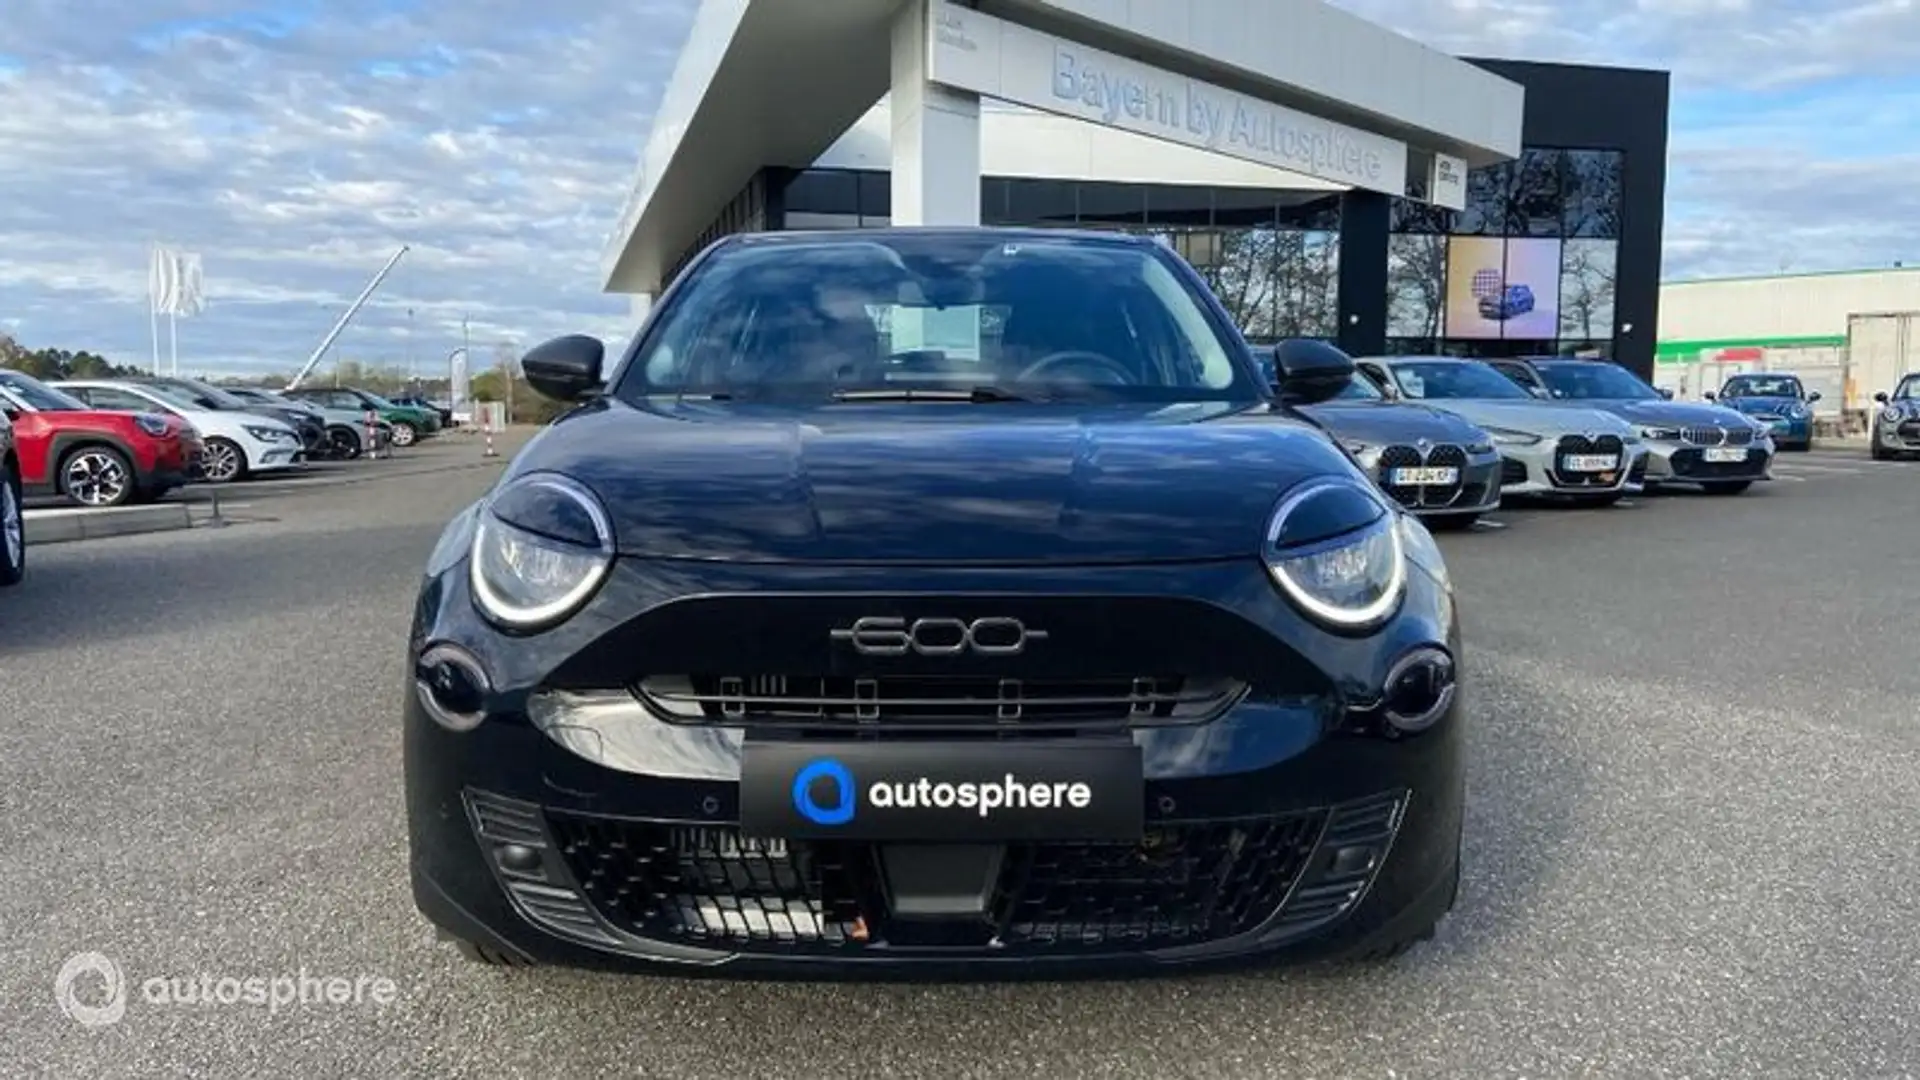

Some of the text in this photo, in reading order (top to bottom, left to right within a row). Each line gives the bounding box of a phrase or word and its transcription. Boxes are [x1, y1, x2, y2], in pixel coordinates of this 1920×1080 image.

[1053, 45, 1382, 180] Bayern by Autosphere
[844, 616, 1034, 654] 600
[868, 772, 1092, 818] autosphere
